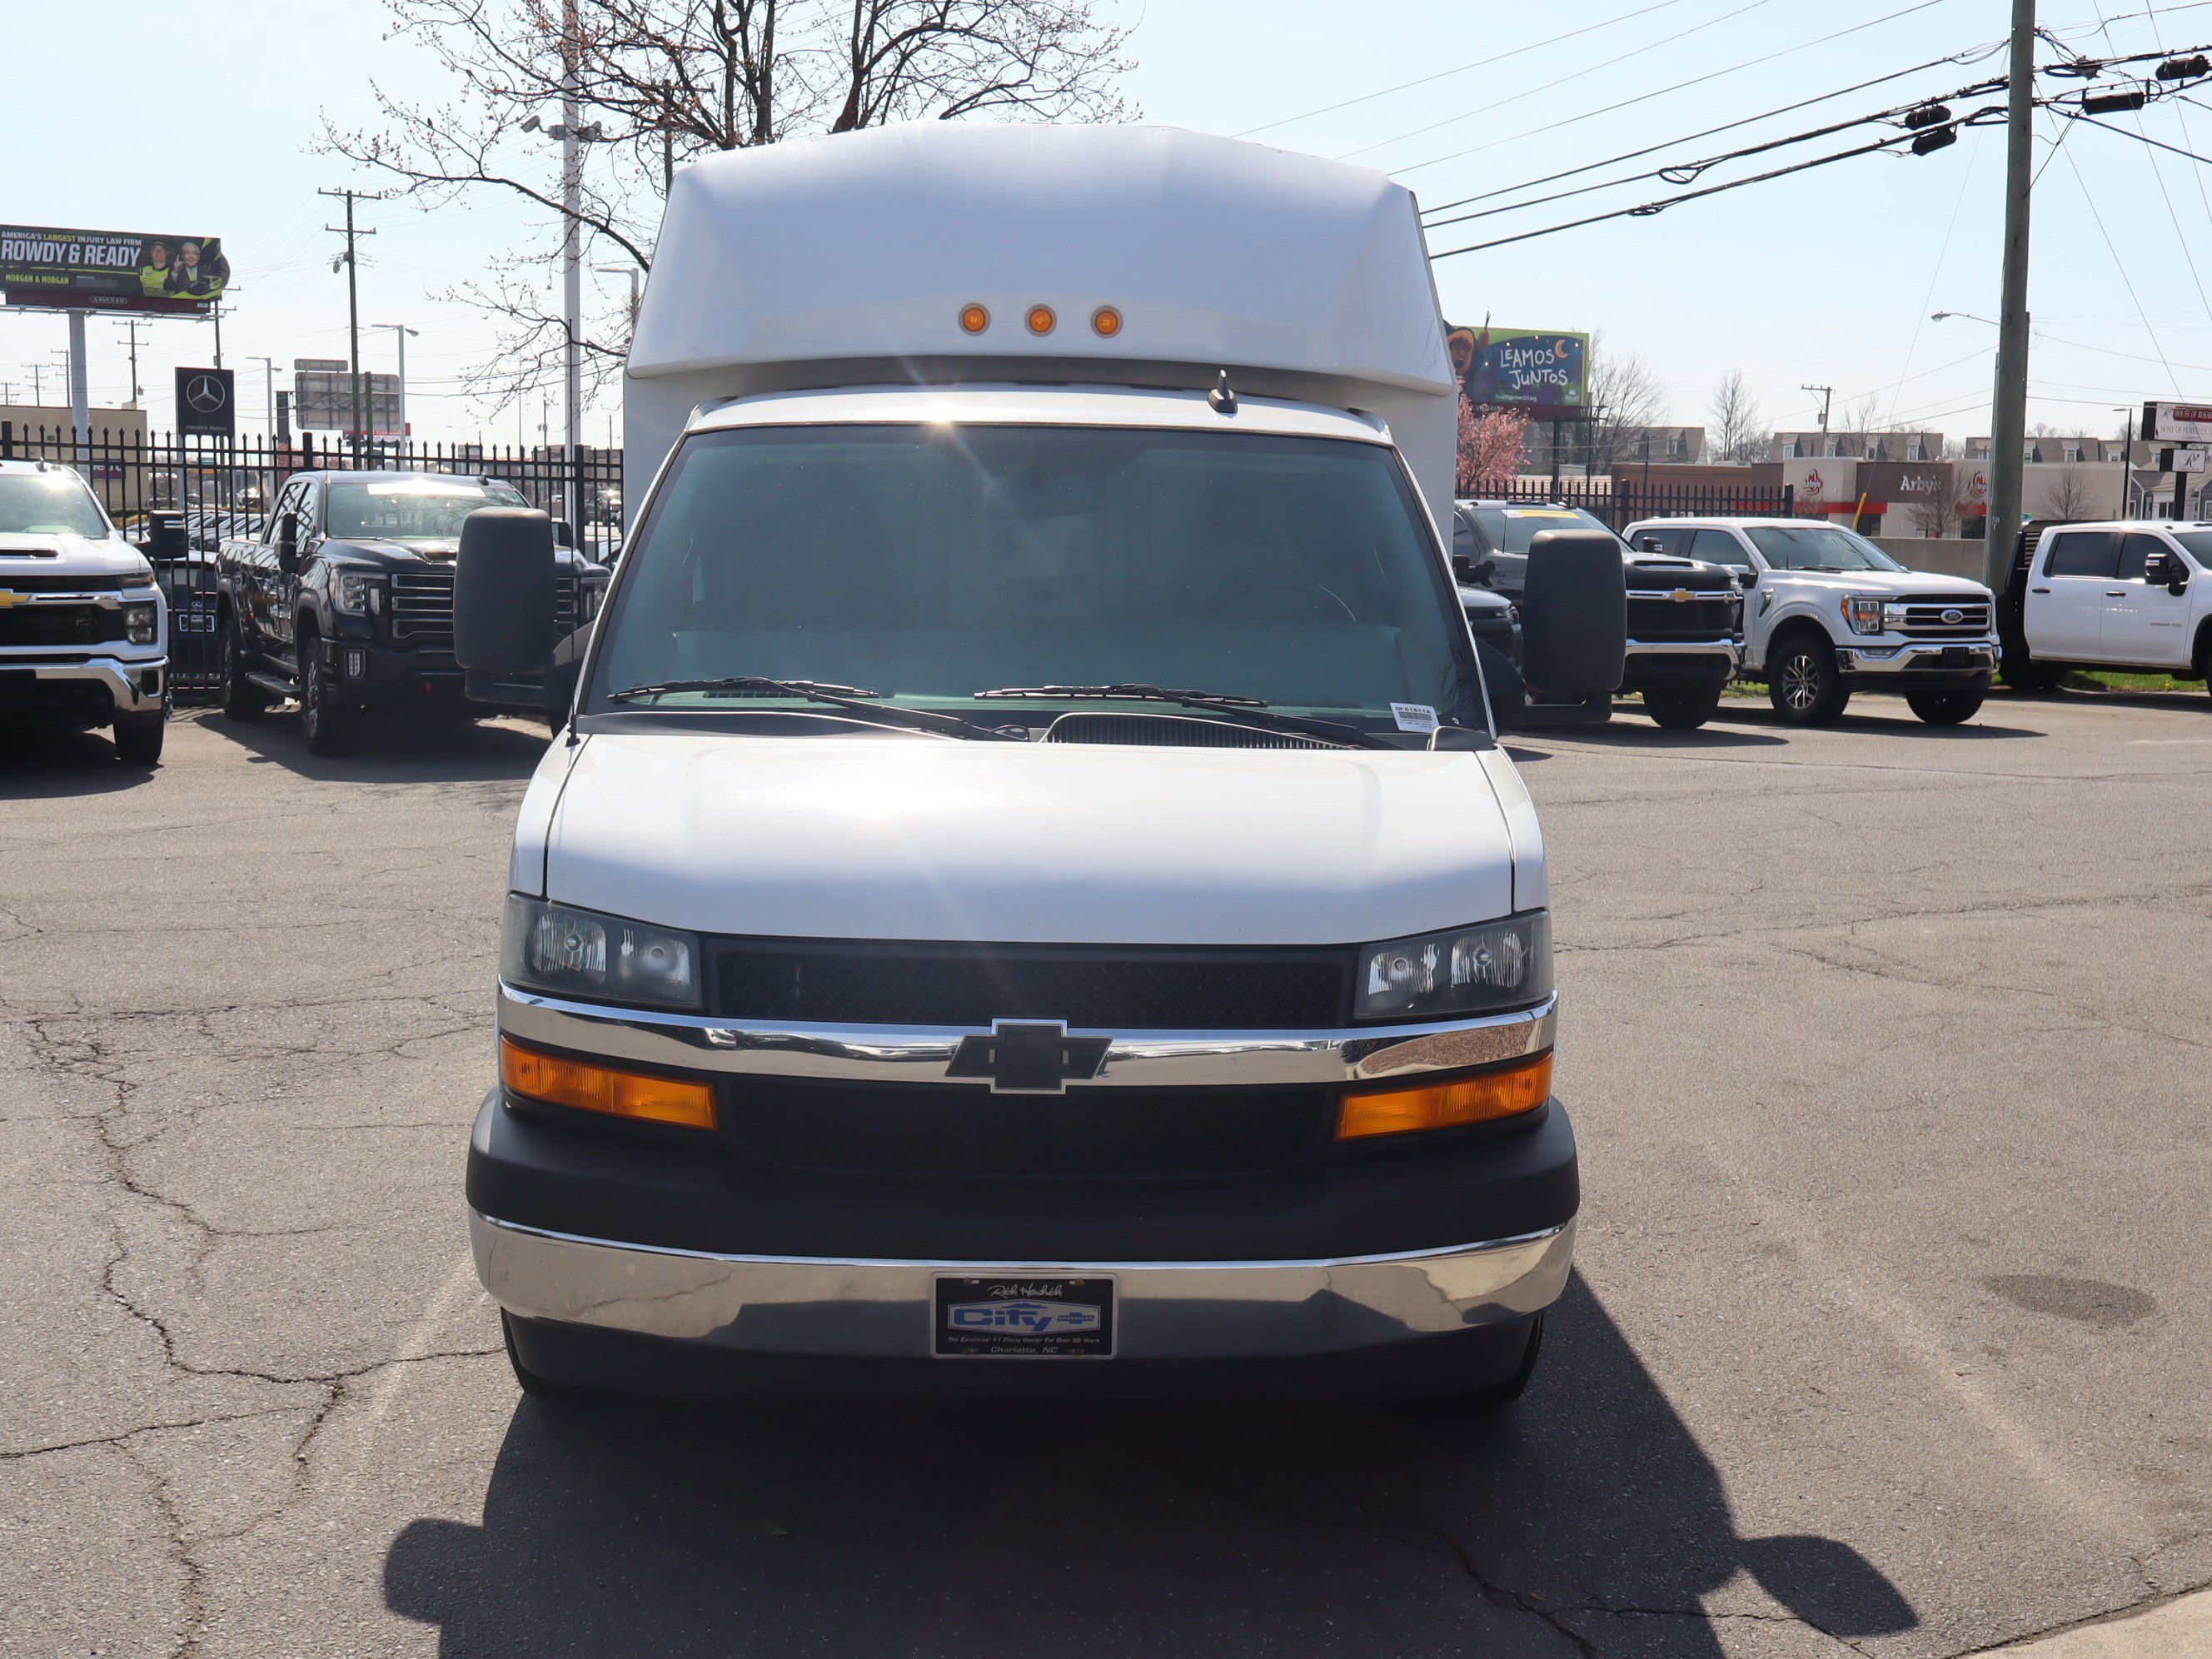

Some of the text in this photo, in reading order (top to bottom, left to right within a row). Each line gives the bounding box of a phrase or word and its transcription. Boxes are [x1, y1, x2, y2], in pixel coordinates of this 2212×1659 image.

[1, 231, 42, 240] AMERICA'S
[43, 234, 76, 242] LARGEST
[1, 239, 141, 267] ROWDY & READY
[5, 273, 69, 285] MORGAN & MORGAN
[1500, 348, 1555, 368] LEAMOS
[987, 1284, 1018, 1299] Rick
[954, 1308, 1054, 1332] City
[990, 1346, 1039, 1354] Charlotte,
